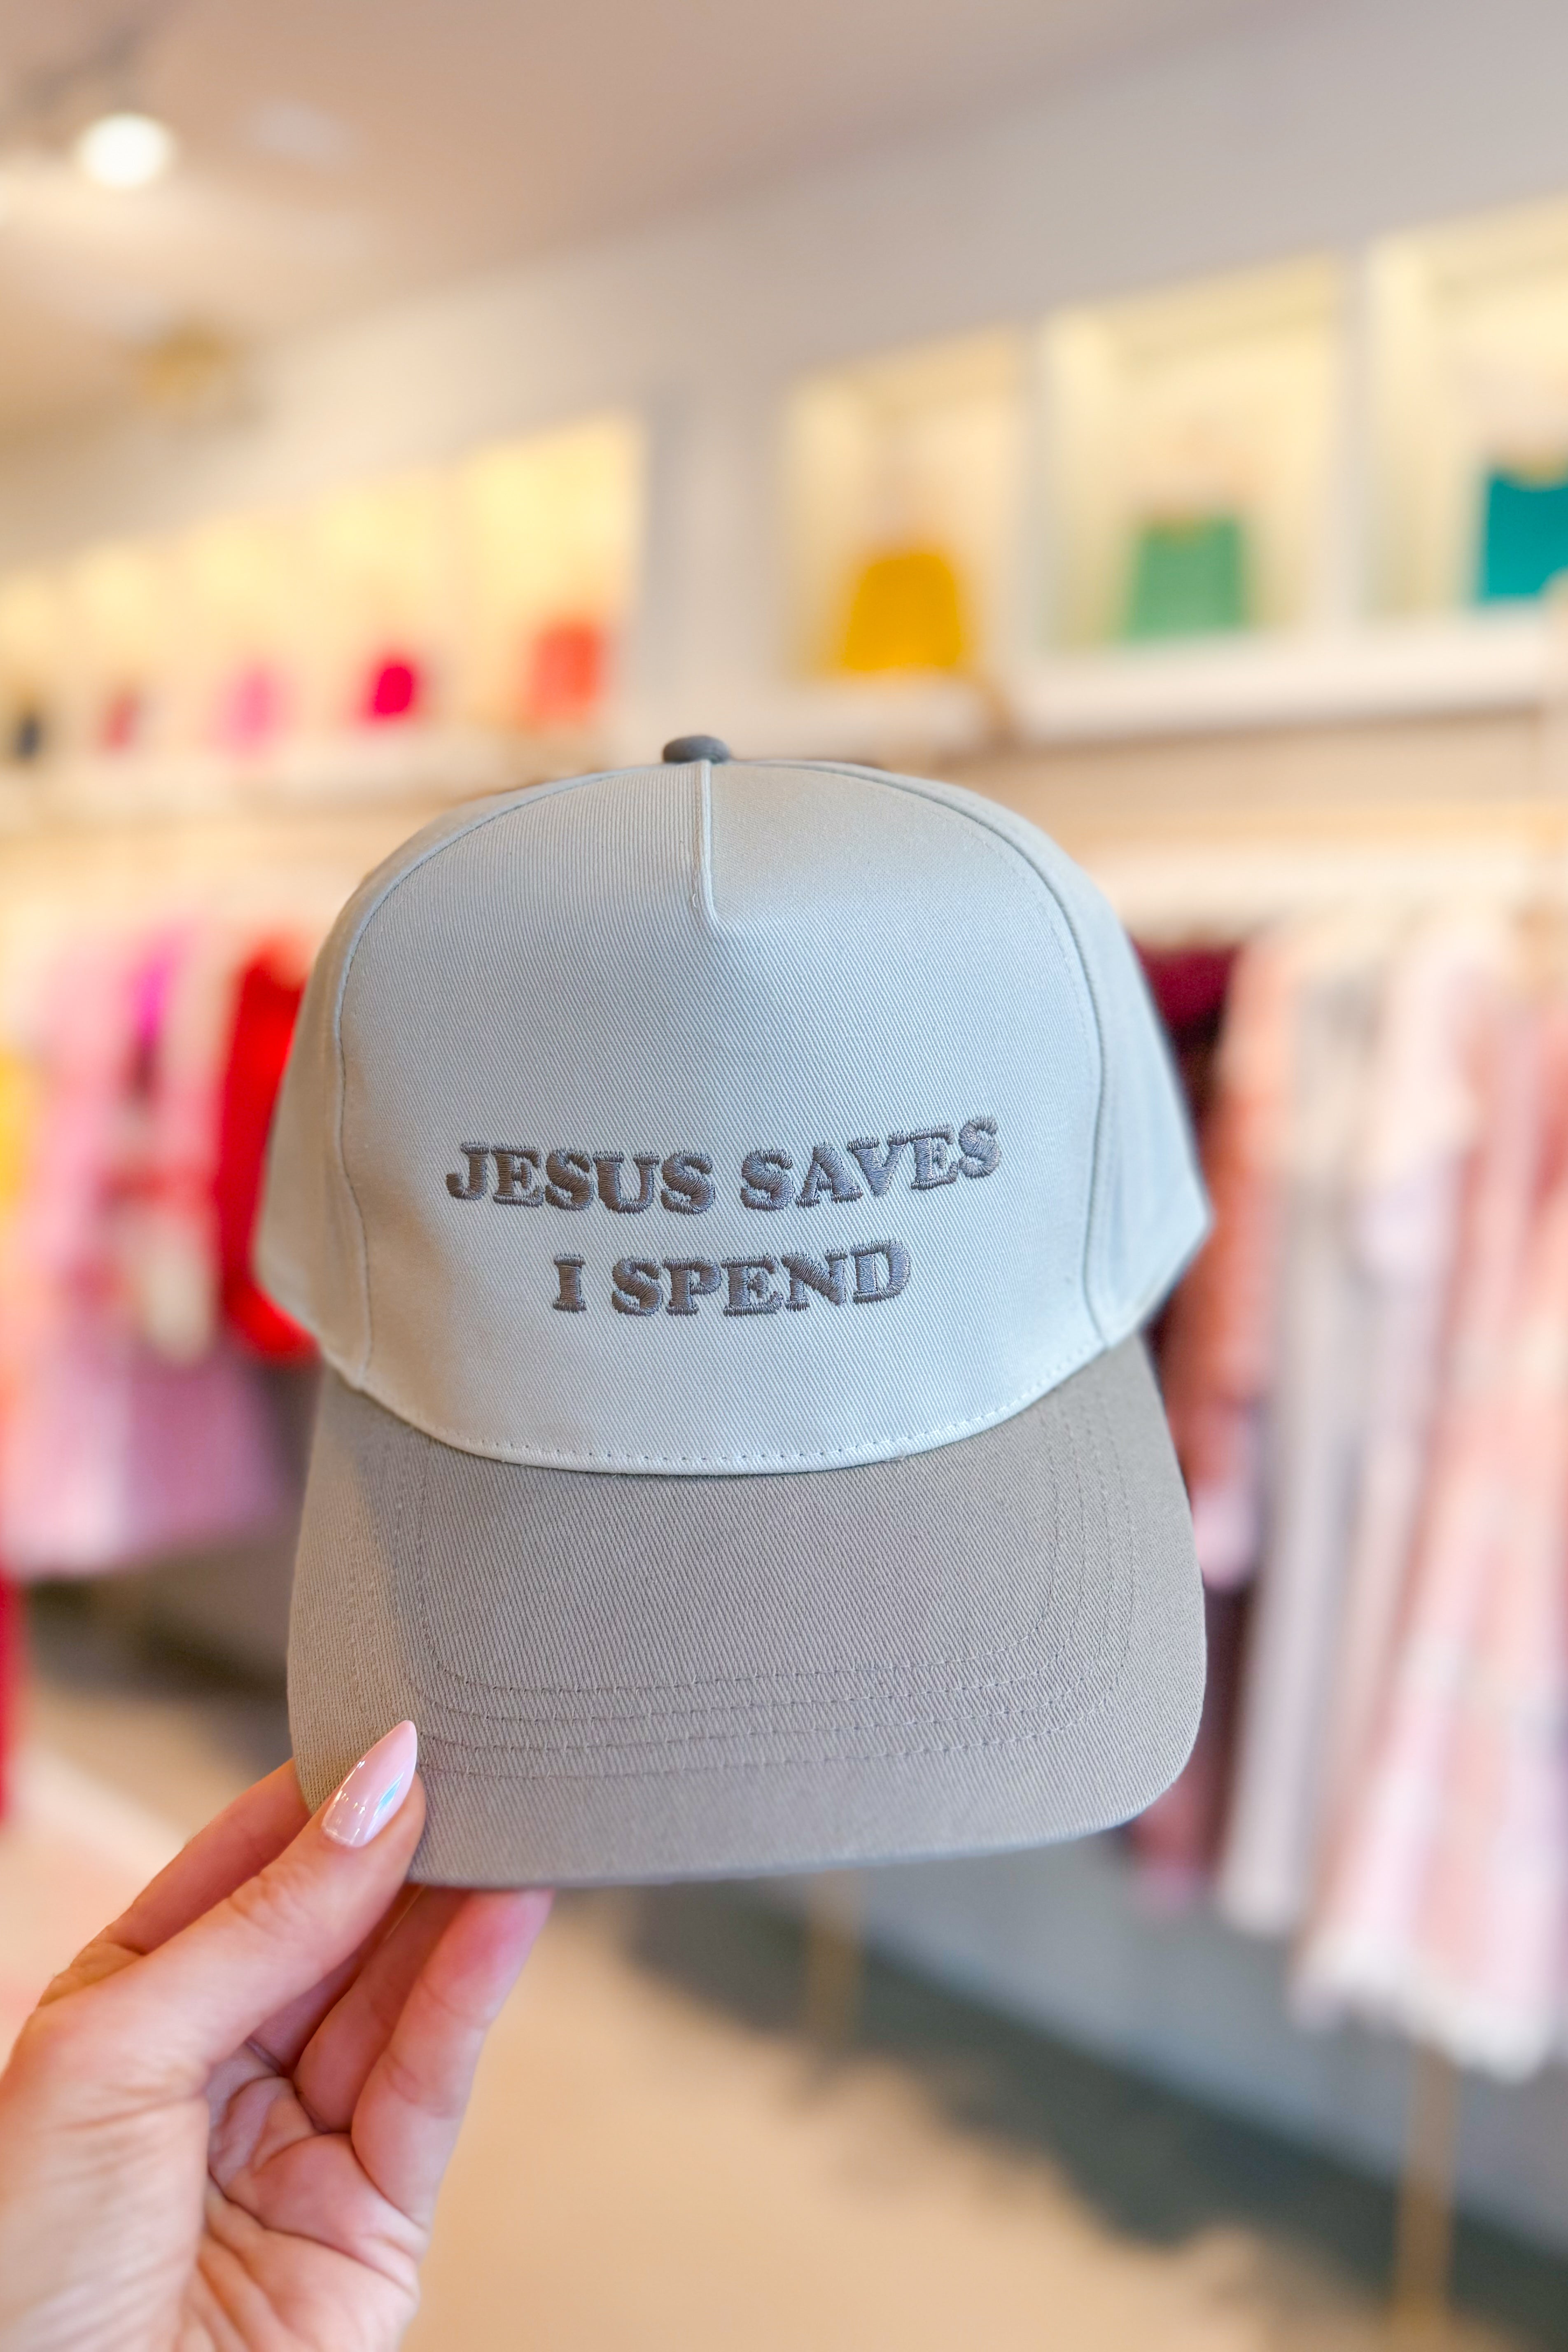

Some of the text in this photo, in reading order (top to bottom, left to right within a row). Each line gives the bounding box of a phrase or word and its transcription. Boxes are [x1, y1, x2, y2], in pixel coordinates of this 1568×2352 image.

[446, 1115, 1002, 1215] JESUS SAVES
[553, 1239, 910, 1317] I SPEND
